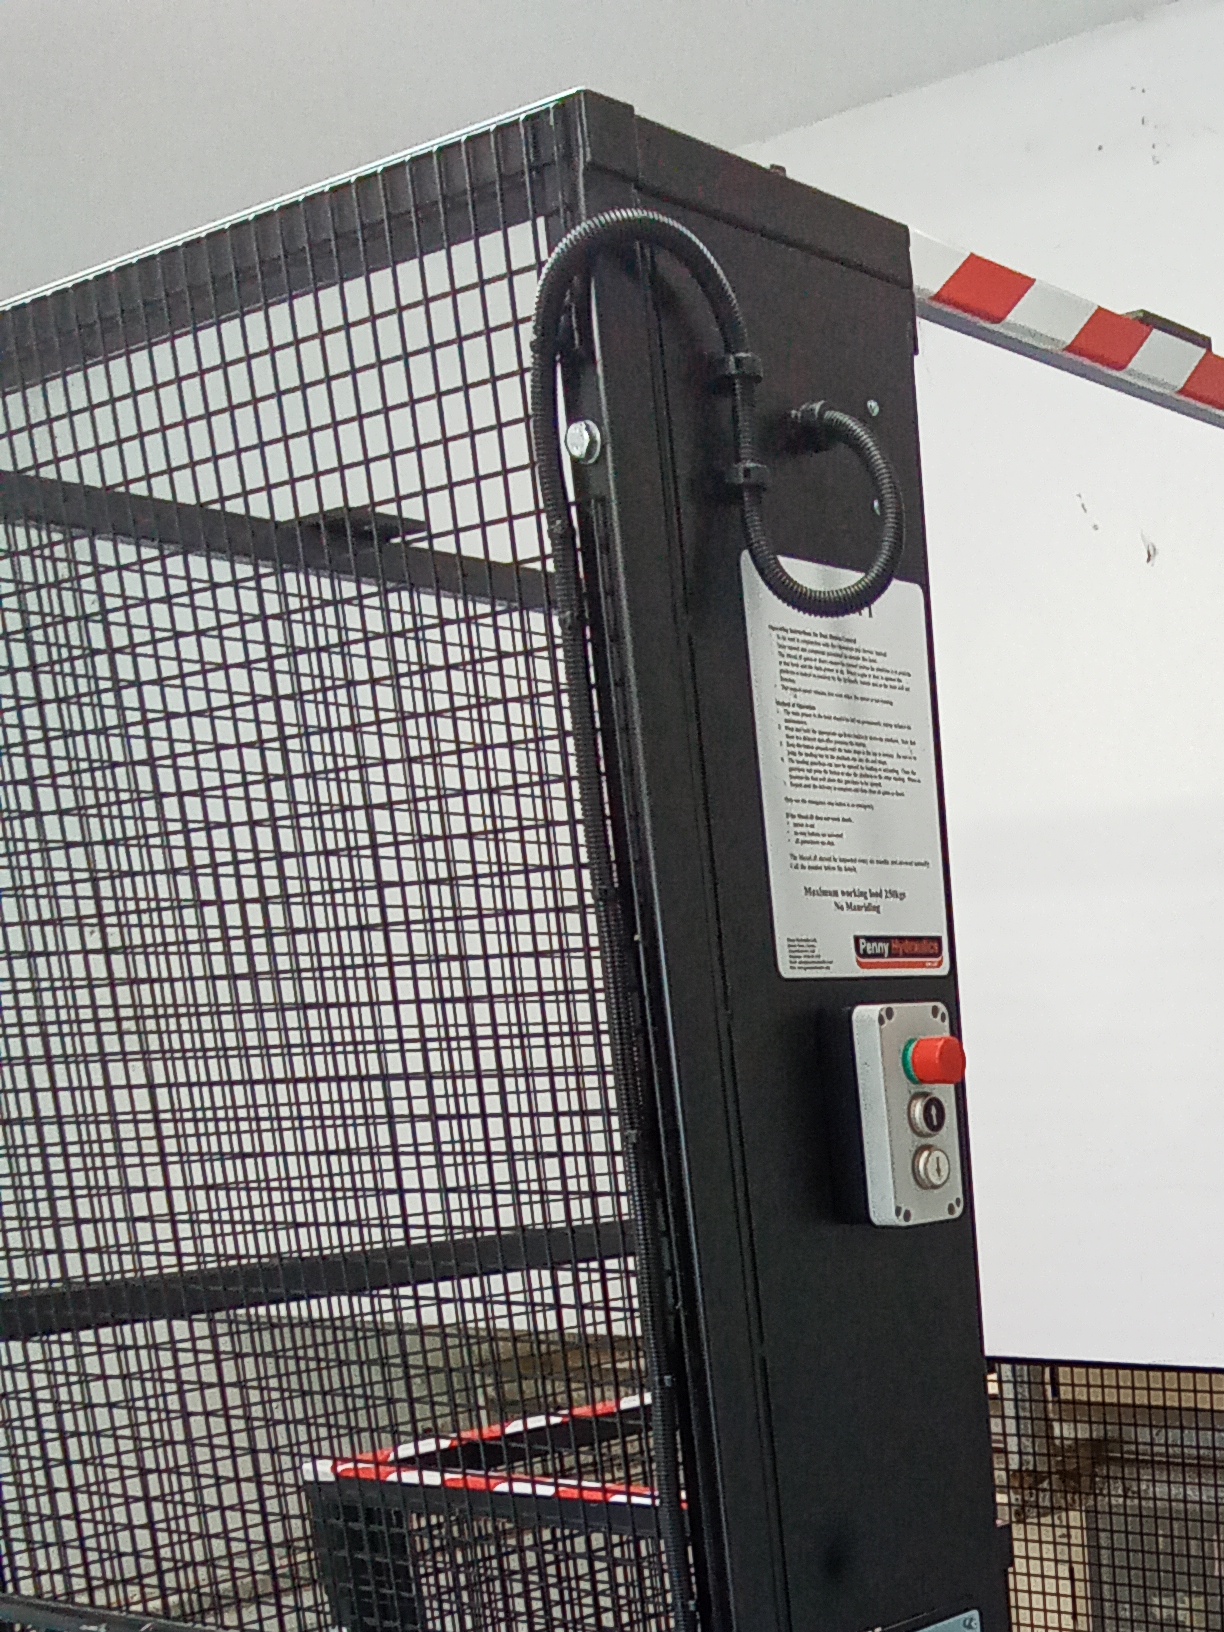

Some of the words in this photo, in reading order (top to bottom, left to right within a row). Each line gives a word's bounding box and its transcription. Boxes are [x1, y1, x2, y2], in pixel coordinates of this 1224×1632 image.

[803, 886, 839, 898] Maximum
[841, 888, 868, 900] working
[869, 889, 883, 899] load
[834, 901, 845, 912] No
[846, 901, 881, 914] Manriding
[859, 938, 890, 958] Penny
[891, 938, 939, 956] Hydraulics
